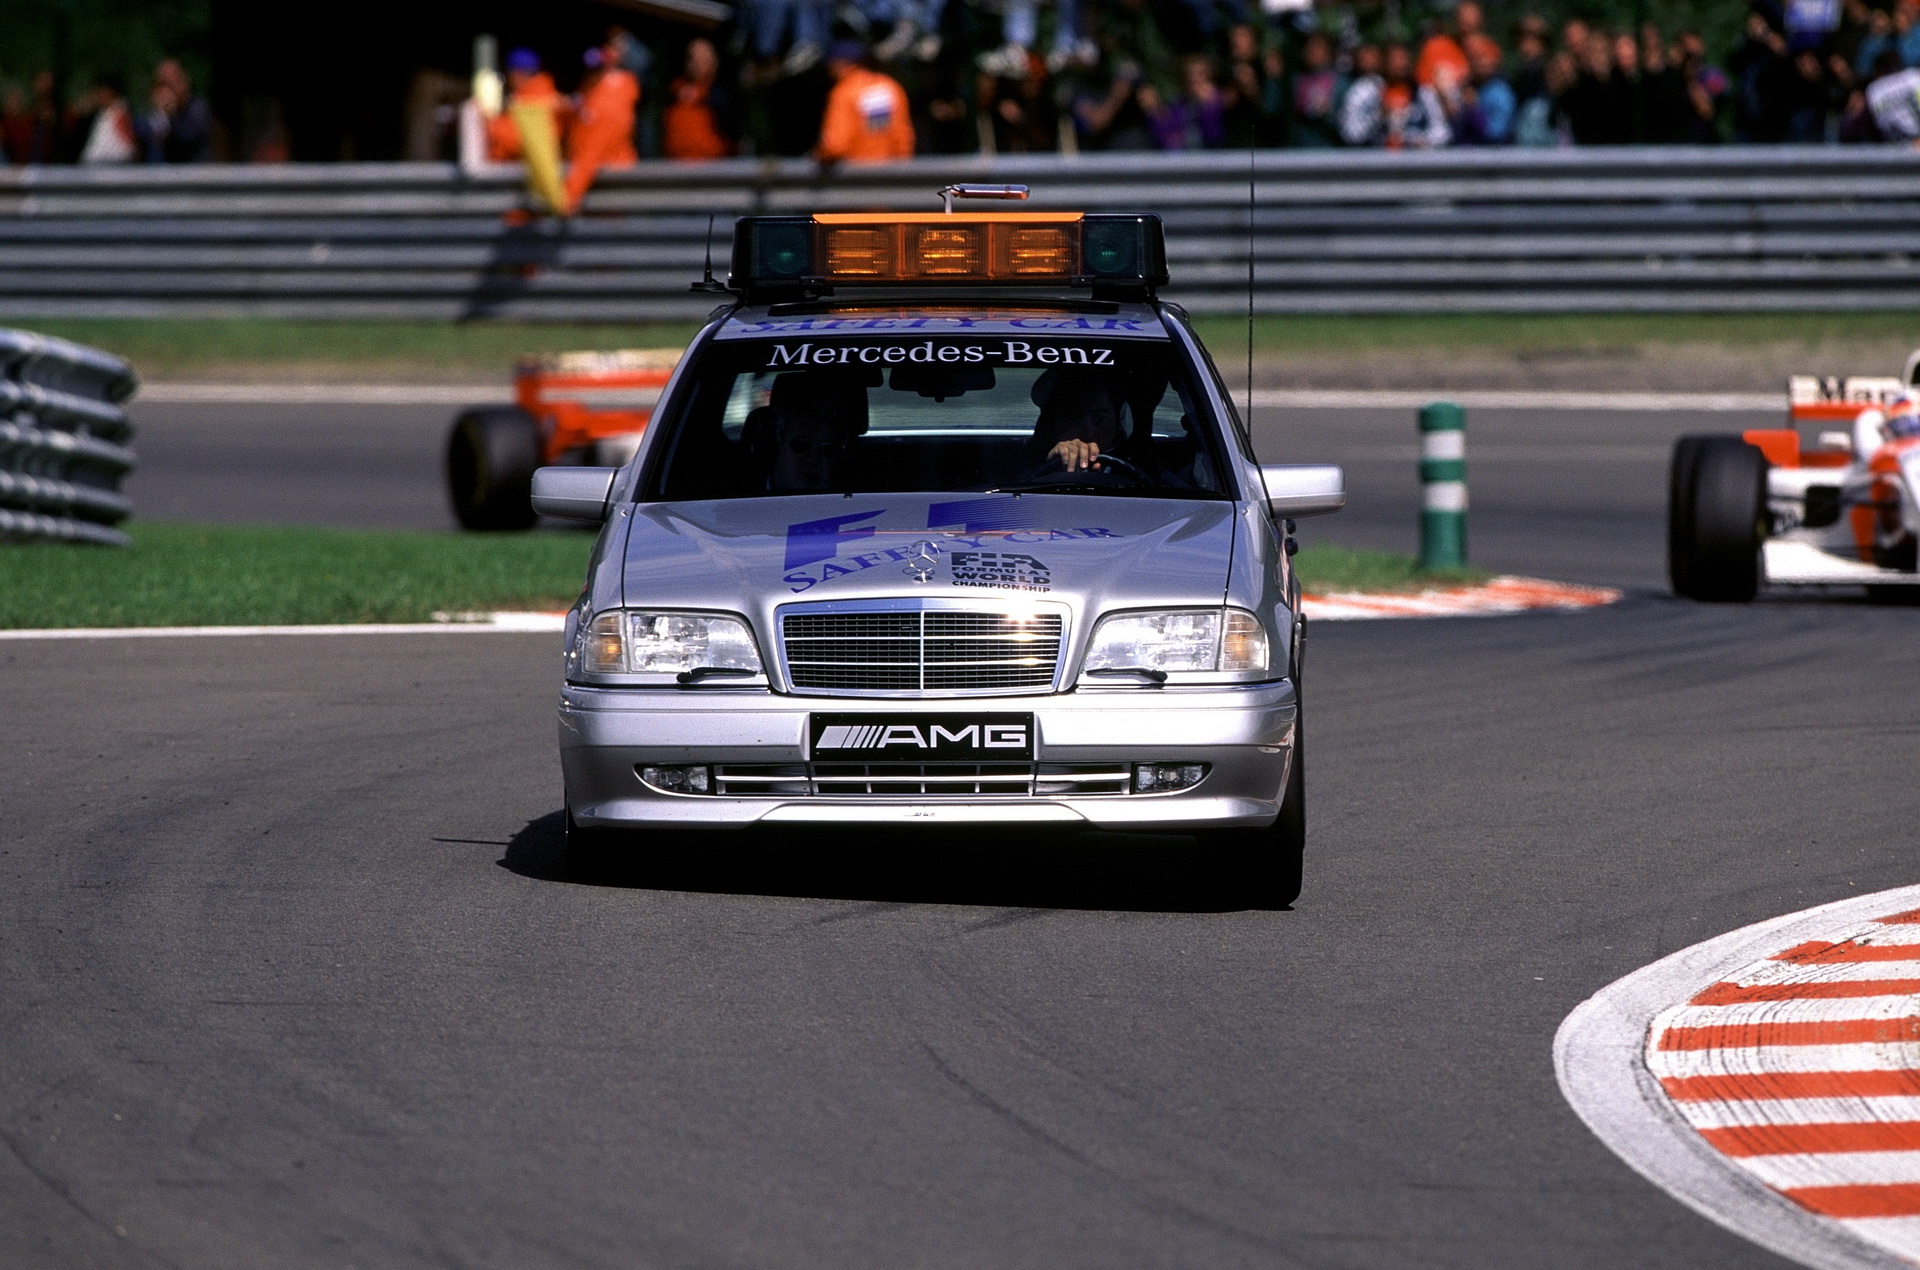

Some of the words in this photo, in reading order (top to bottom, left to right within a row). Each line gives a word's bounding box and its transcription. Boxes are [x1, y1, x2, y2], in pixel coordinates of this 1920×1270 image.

[741, 317, 984, 333] SAFETY
[1009, 317, 1145, 332] CAR
[765, 341, 1115, 366] Mercedes-Benz
[783, 537, 988, 593] SAFETY
[1003, 527, 1125, 543] CAR
[951, 552, 1049, 570] FIA
[951, 566, 1039, 575] FORMULA
[952, 573, 1050, 584] WORLD
[951, 581, 1050, 593] CHAMPIONSHIP
[877, 724, 1027, 749] AMG
